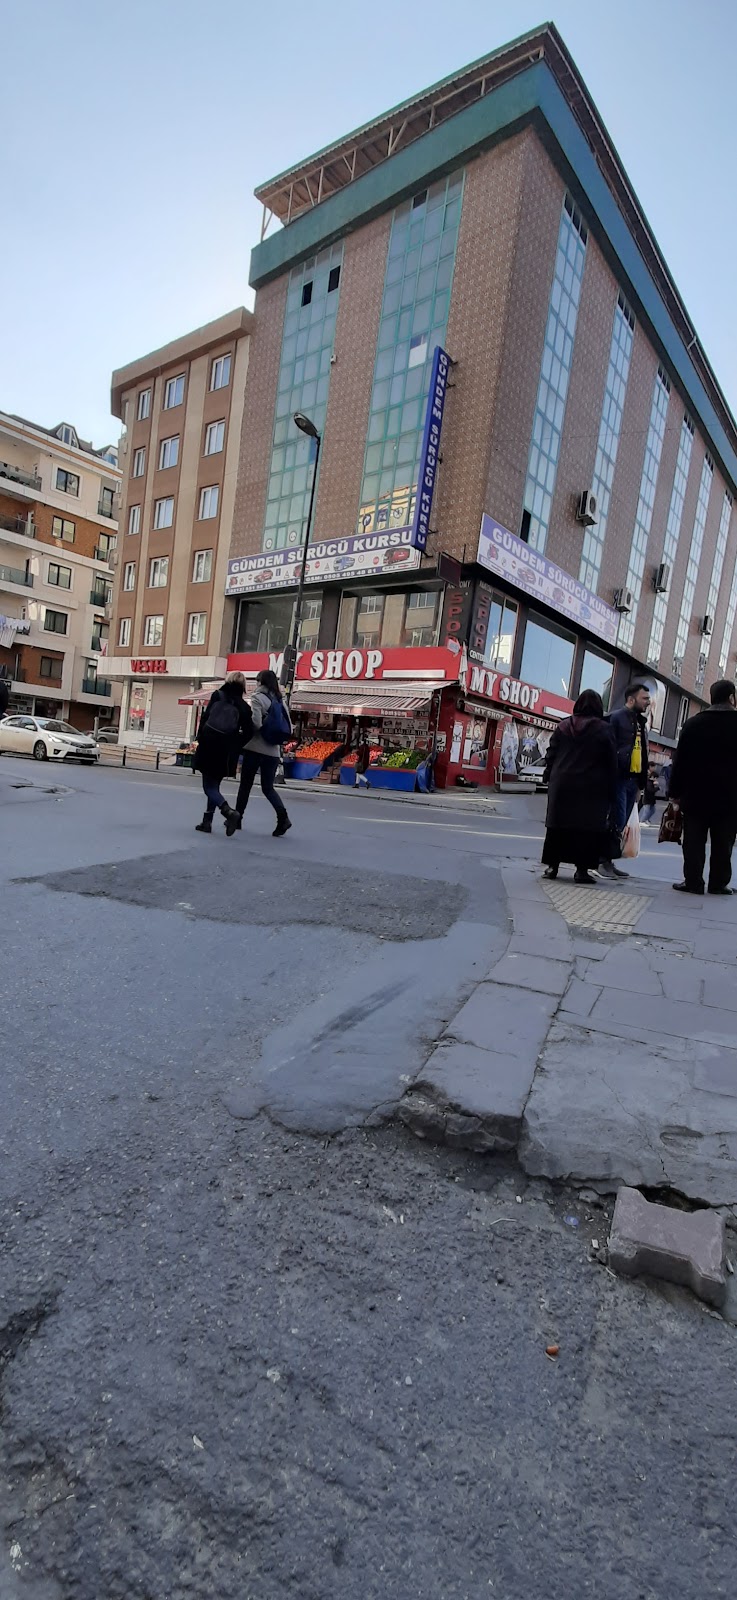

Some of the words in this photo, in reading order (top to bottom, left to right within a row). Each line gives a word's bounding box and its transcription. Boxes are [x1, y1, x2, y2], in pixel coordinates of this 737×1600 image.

[433, 354, 448, 420] GÜNDEM
[417, 492, 431, 545] KURSU
[231, 555, 284, 573] GÜNDEM
[287, 540, 349, 562] SÜRÜCÜ
[353, 530, 412, 552] KURSU
[493, 527, 546, 574] GÜNDEM
[549, 567, 588, 605] SÜRÜCÜ
[589, 594, 617, 622] KURSU
[131, 659, 168, 673] VESTEL
[310, 650, 384, 679] SHOP
[469, 666, 498, 697] MY
[499, 677, 540, 710] SHOP
[474, 706, 486, 715] MY
[486, 710, 505, 721] SHOP
